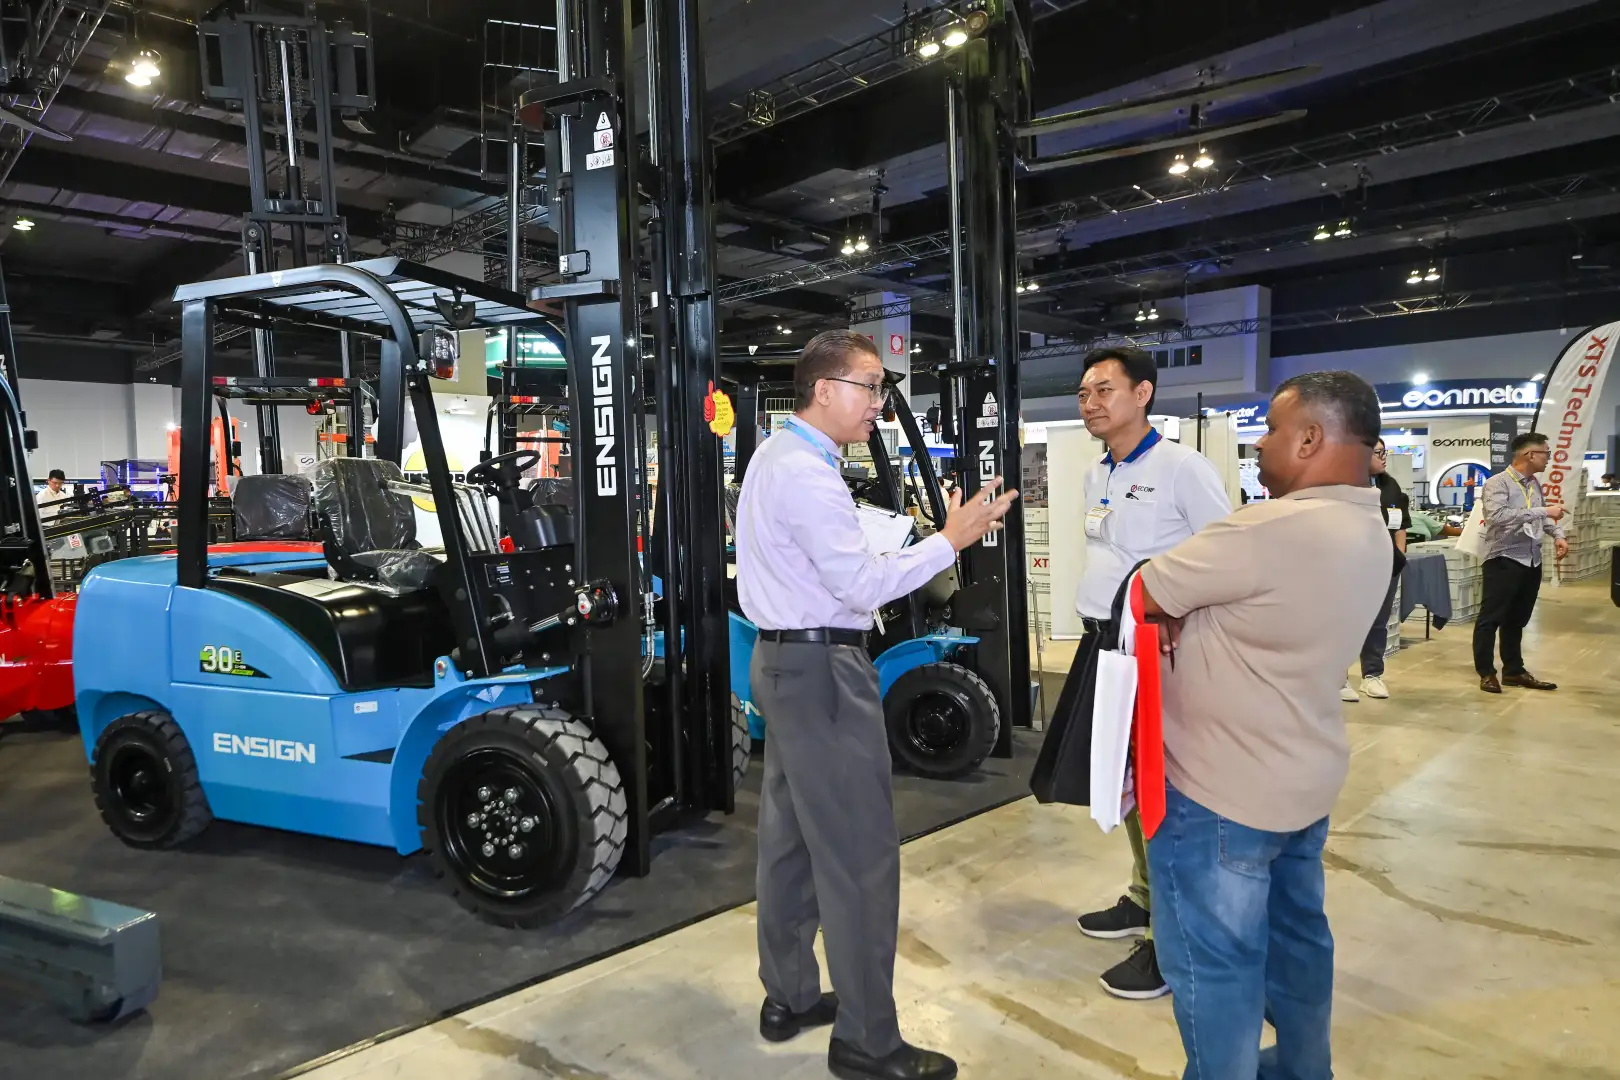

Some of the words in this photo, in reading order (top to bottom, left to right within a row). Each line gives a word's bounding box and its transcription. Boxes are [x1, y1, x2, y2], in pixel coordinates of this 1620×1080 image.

[1578, 335, 1609, 378] XTS
[1402, 383, 1538, 408] eonmetal
[591, 335, 617, 496] ENSIGN
[203, 645, 233, 672] 30
[235, 651, 242, 662] E
[213, 732, 316, 764] ENSIGN
